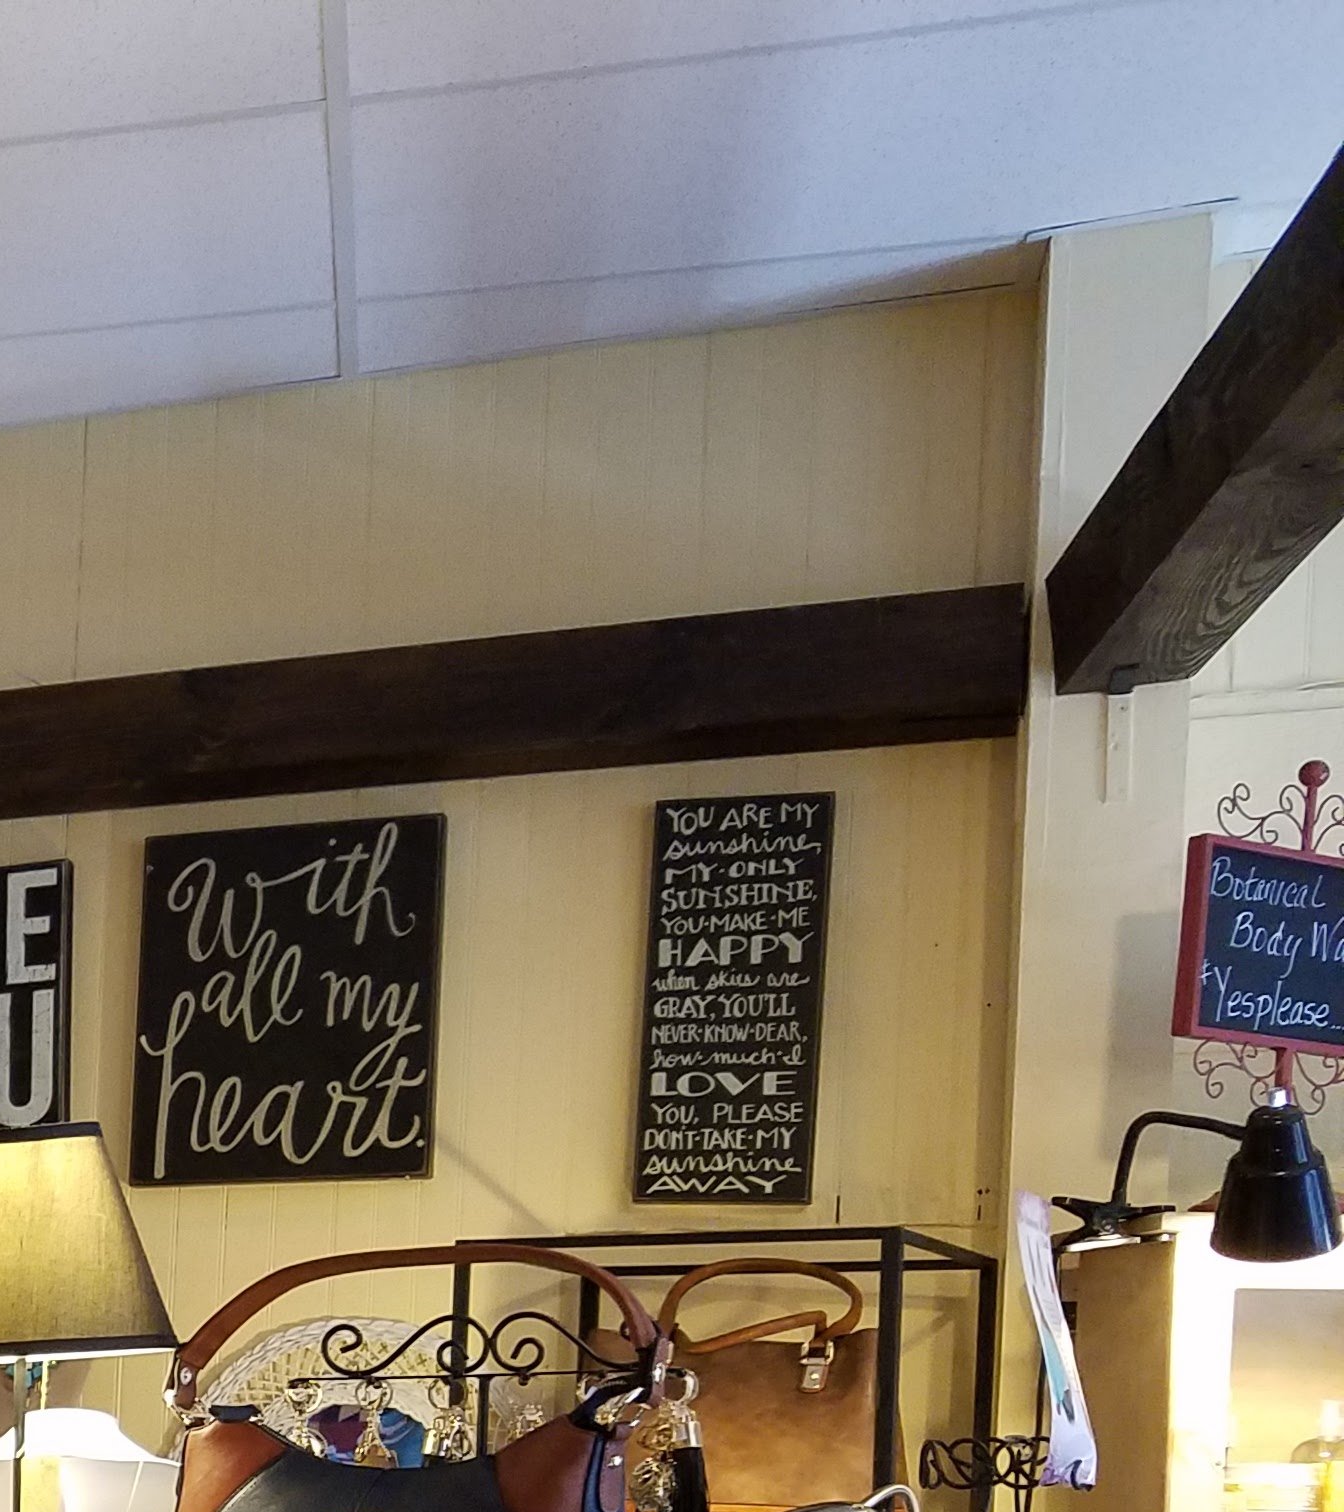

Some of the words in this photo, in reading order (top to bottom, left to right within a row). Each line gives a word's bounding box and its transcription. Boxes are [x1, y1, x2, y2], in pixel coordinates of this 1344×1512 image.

[666, 806, 715, 835] YOU
[719, 803, 774, 831] ARE
[780, 802, 819, 828] MY
[663, 831, 821, 861] sunshine,
[167, 822, 415, 962] With
[661, 879, 818, 915] SUNSHINE,
[1211, 856, 1326, 909] Botanical
[658, 931, 815, 967] HAPPY
[1229, 911, 1302, 978] Body
[1312, 921, 1344, 962] Wa
[651, 969, 700, 992] when
[704, 968, 760, 991] skies
[767, 972, 810, 987] are
[201, 929, 302, 1042] all
[320, 972, 423, 1092] my
[653, 995, 717, 1021] GRAY,
[717, 993, 796, 1018] YOU'LL
[650, 1071, 797, 1097] LOVE
[650, 1102, 700, 1125] YOU,
[712, 1102, 804, 1124] PLEASE
[642, 1151, 802, 1175] sunshine
[646, 1175, 787, 1194] AWAY
